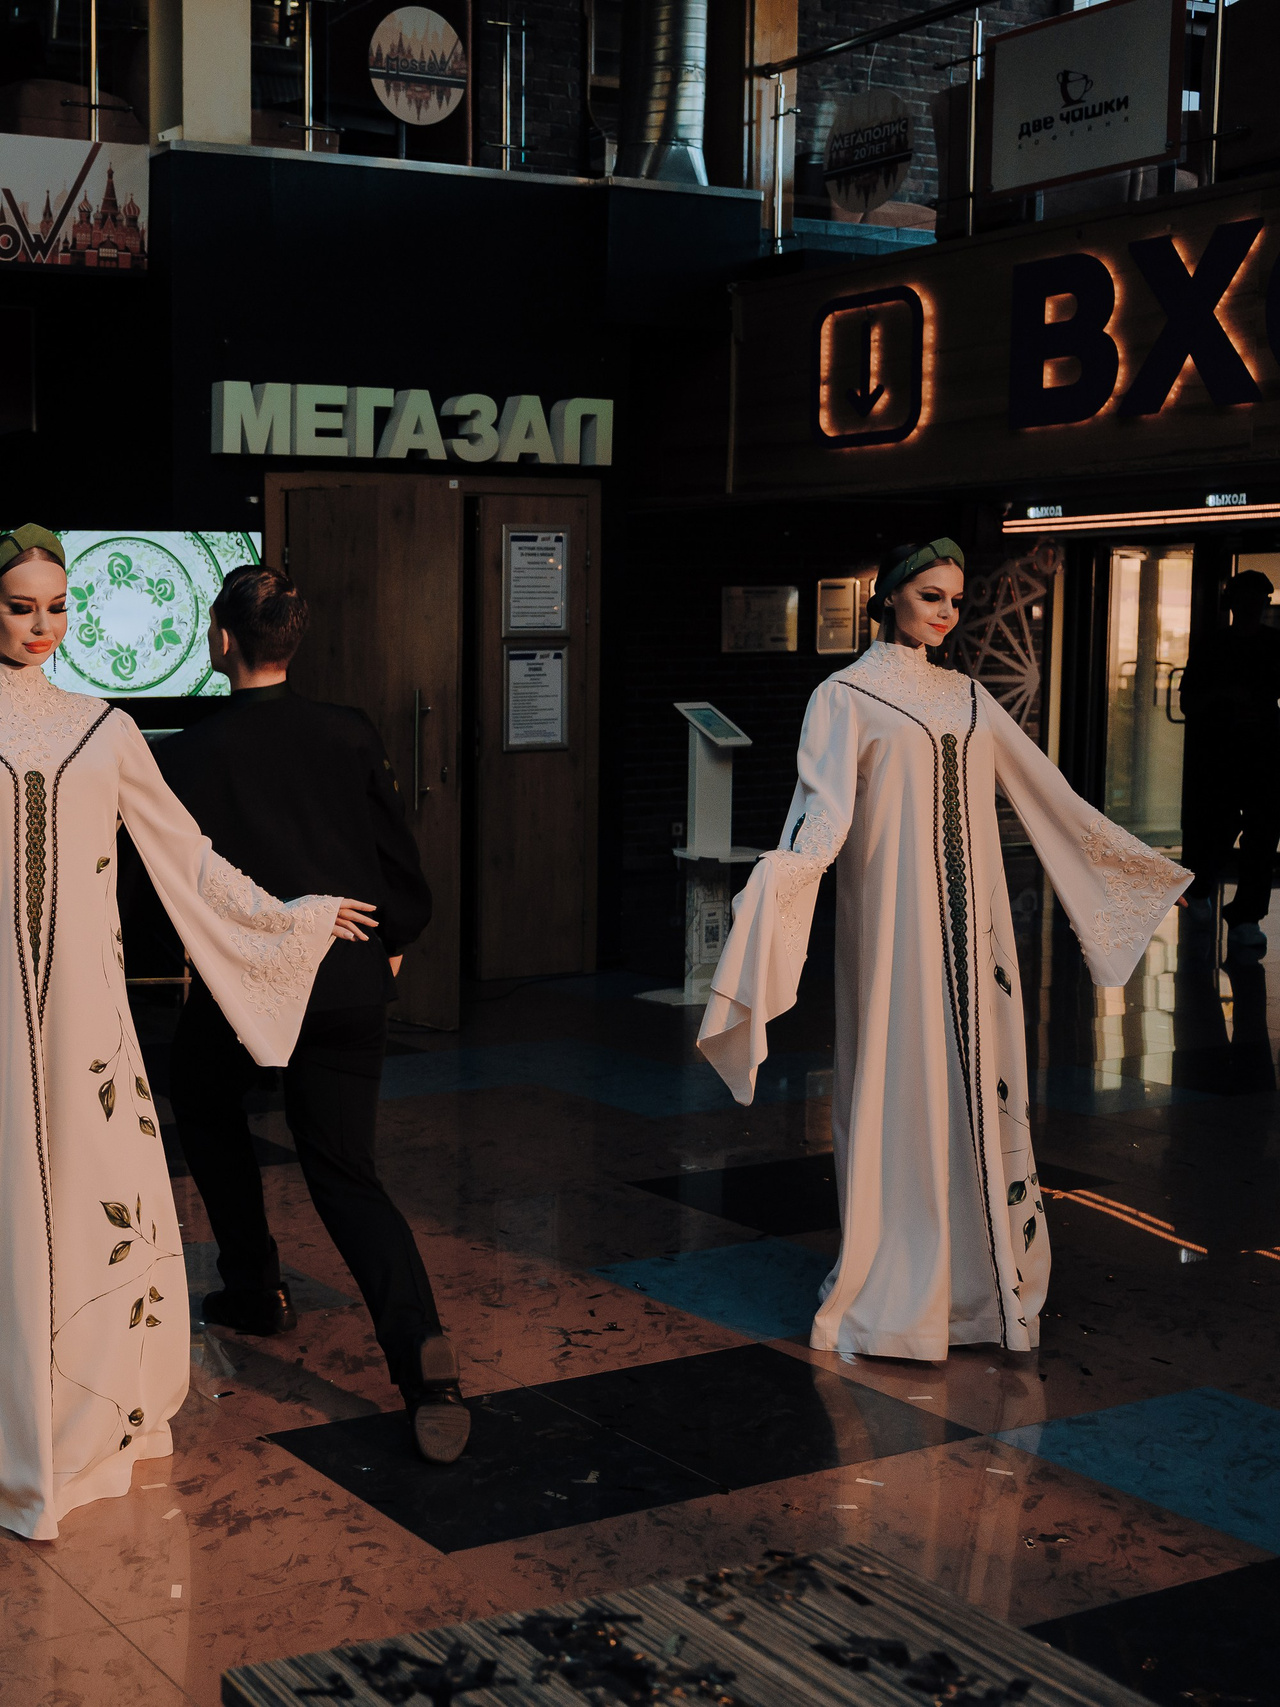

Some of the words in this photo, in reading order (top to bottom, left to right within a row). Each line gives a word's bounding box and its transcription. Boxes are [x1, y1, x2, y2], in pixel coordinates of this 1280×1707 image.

[831, 118, 908, 152] МЕГАПОЛИС
[853, 147, 866, 160] 20
[868, 141, 888, 157] ЛЕТ
[1011, 217, 1280, 430] ВХ
[1208, 493, 1246, 506] ВЫХОД
